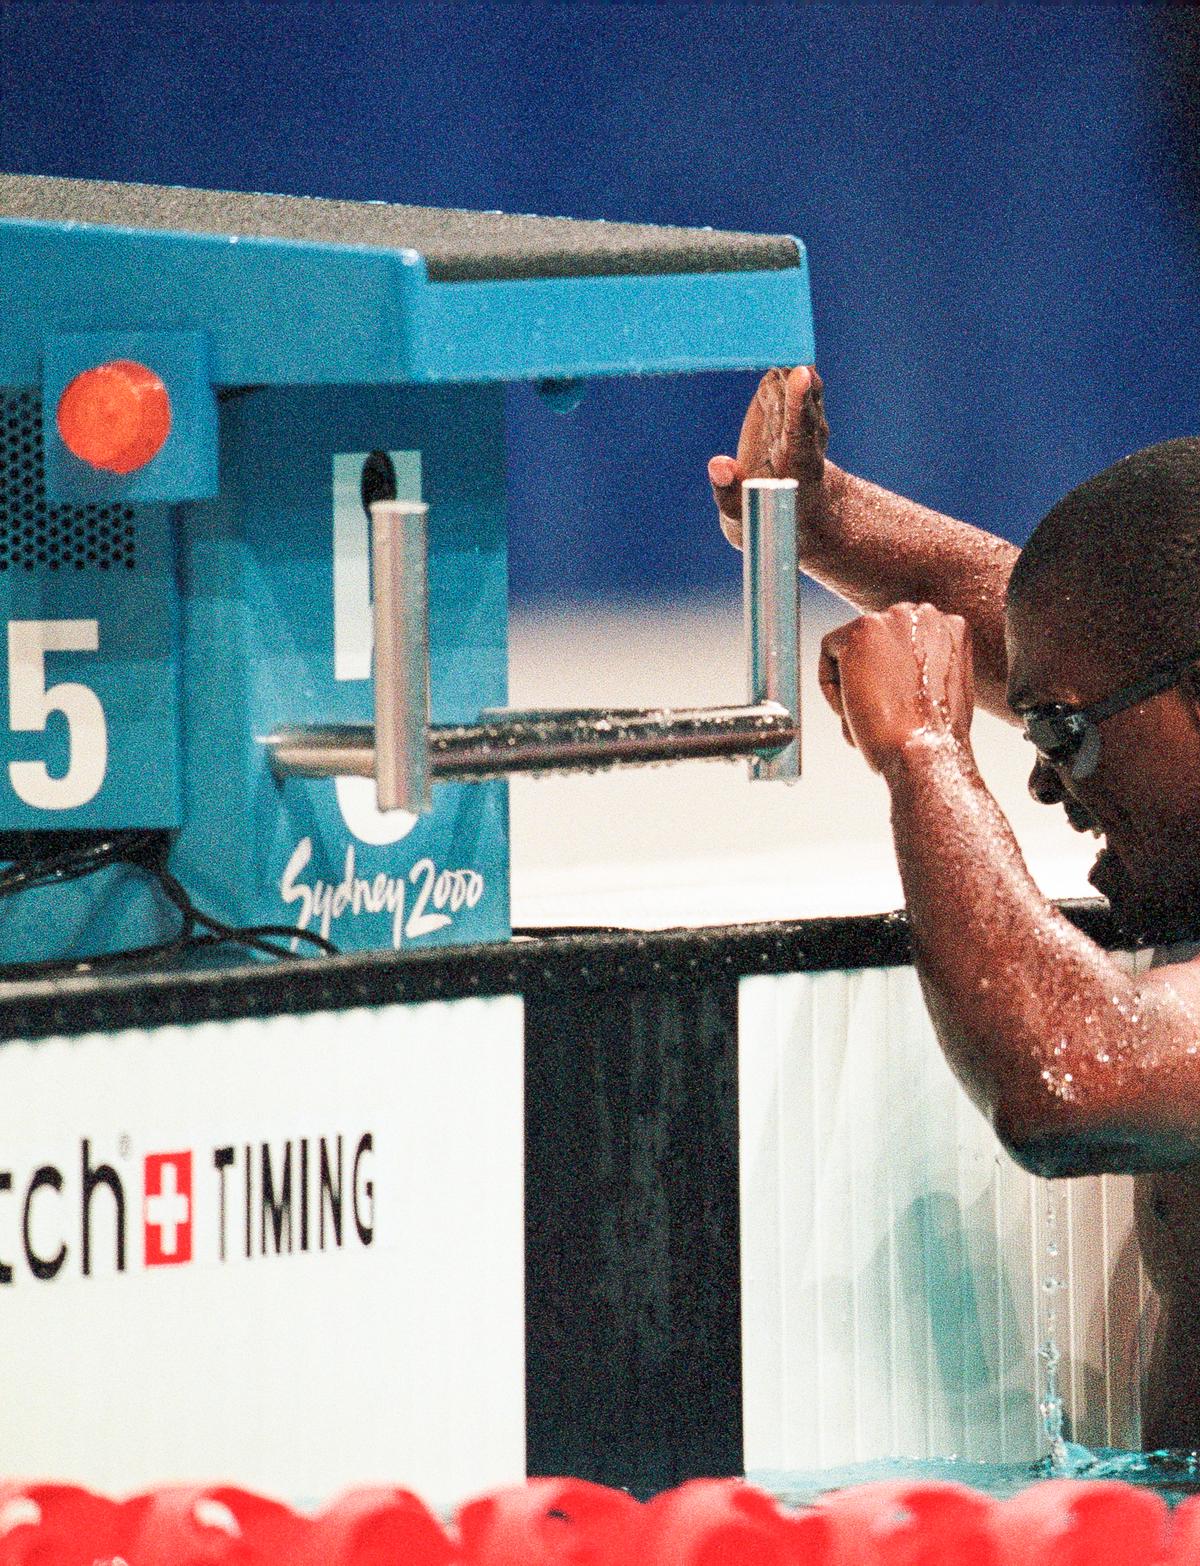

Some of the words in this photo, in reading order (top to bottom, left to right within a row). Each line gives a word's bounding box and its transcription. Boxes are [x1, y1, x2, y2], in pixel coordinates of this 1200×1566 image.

[8, 618, 107, 810] 5
[281, 836, 405, 956] Sydney
[405, 857, 484, 939] 2000
[213, 1132, 374, 1262] TIMING
